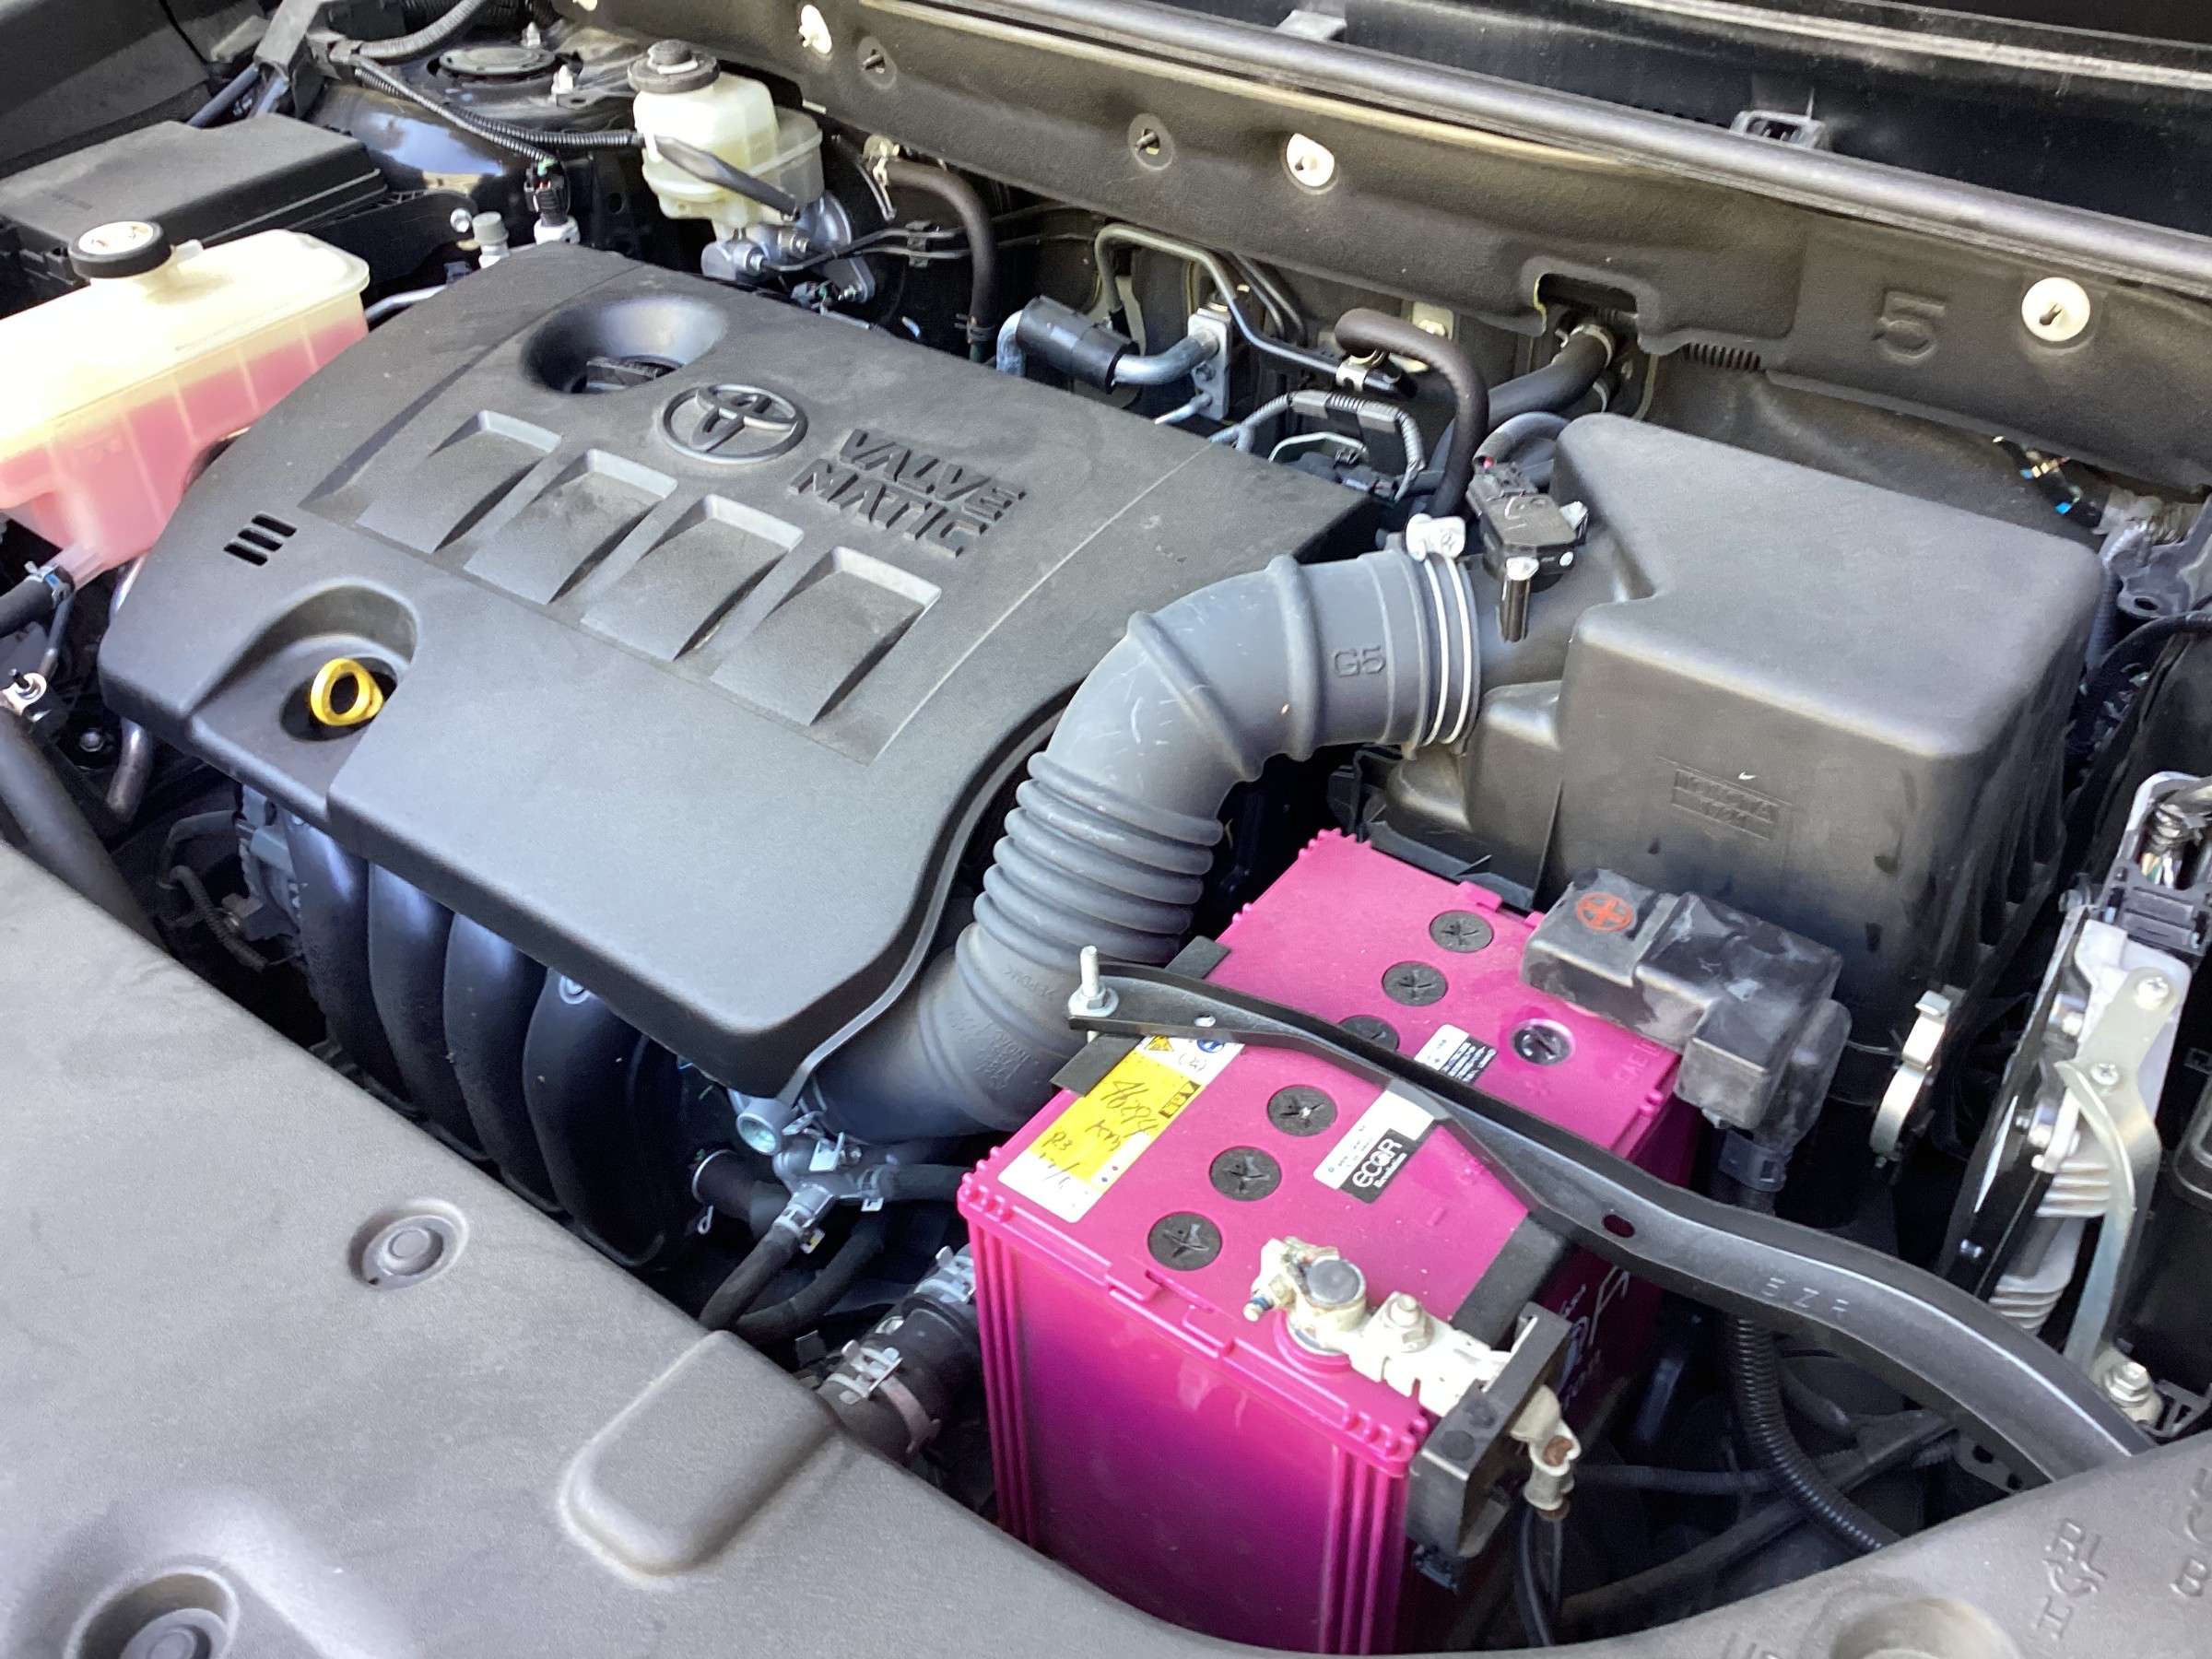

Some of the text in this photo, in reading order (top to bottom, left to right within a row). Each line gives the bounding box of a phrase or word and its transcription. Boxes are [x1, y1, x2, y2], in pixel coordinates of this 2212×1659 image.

[1871, 287, 1948, 366] 5
[787, 459, 988, 559] MATIC
[840, 429, 1027, 523] VALVE
[1334, 646, 1386, 678] G5
